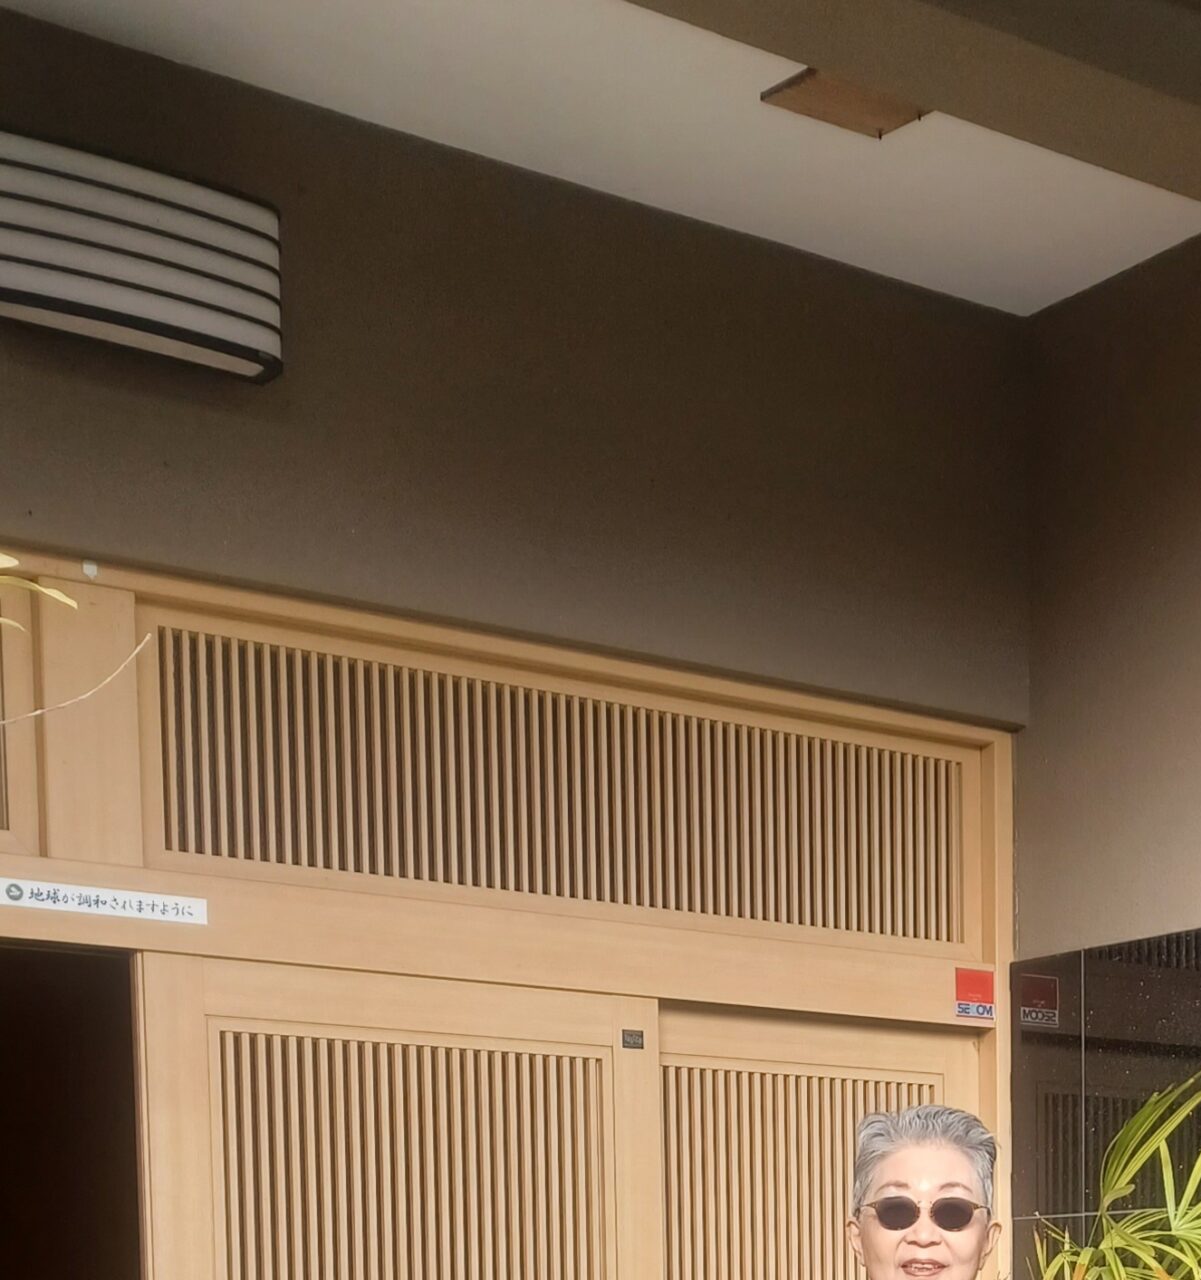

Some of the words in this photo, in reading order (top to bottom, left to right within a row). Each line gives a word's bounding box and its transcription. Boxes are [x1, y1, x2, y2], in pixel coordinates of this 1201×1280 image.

[28, 887, 194, 917] 地球が調和されますように
[957, 1002, 993, 1016] SEOM
